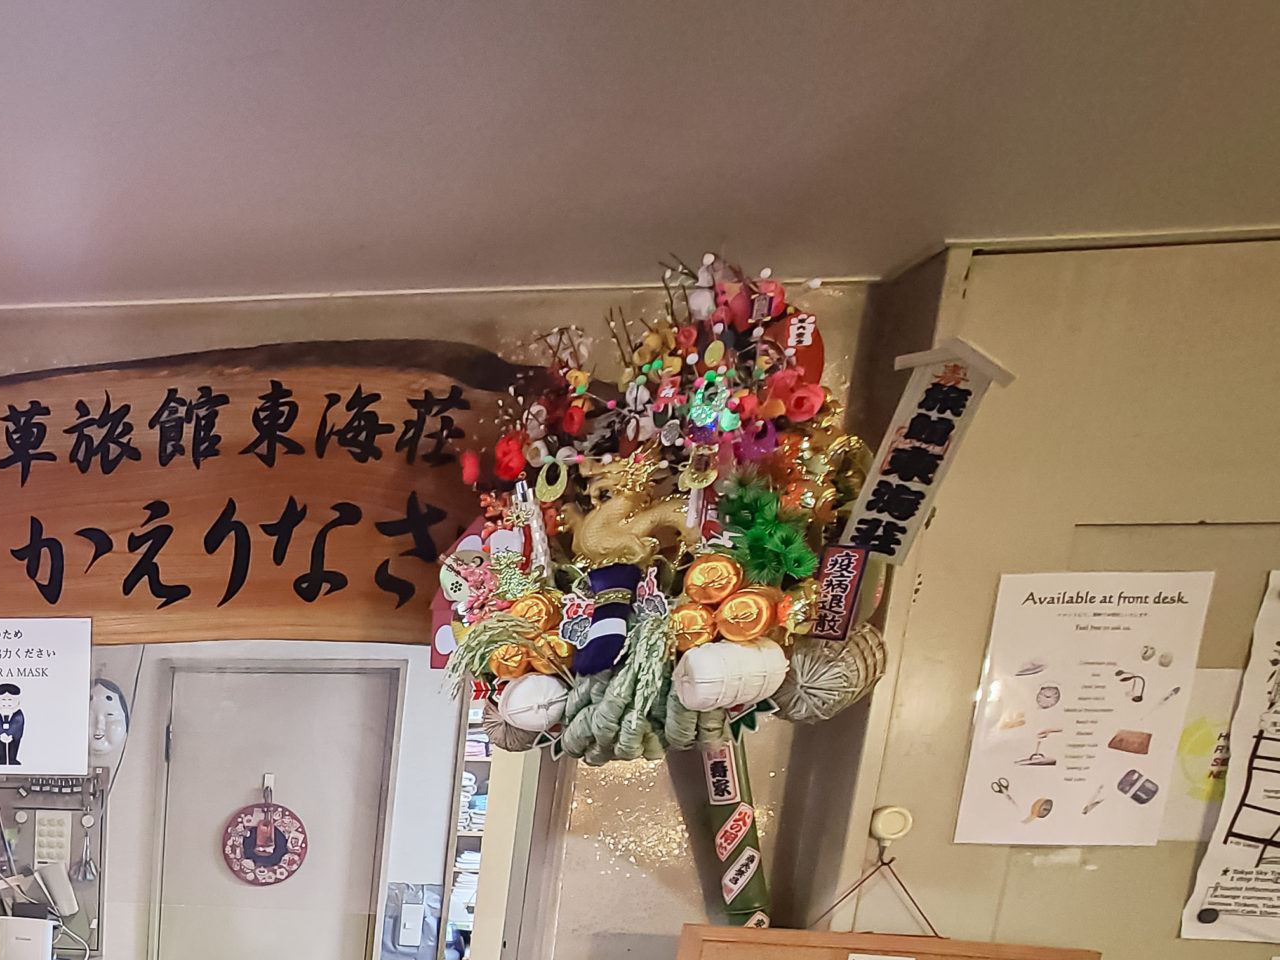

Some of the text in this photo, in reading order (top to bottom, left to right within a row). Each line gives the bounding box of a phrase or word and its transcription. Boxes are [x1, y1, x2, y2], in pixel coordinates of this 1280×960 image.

[814, 551, 858, 634] 疫病退散
[1022, 591, 1188, 606] Available at front desk
[6, 668, 14, 677] A
[17, 667, 49, 677] MASK
